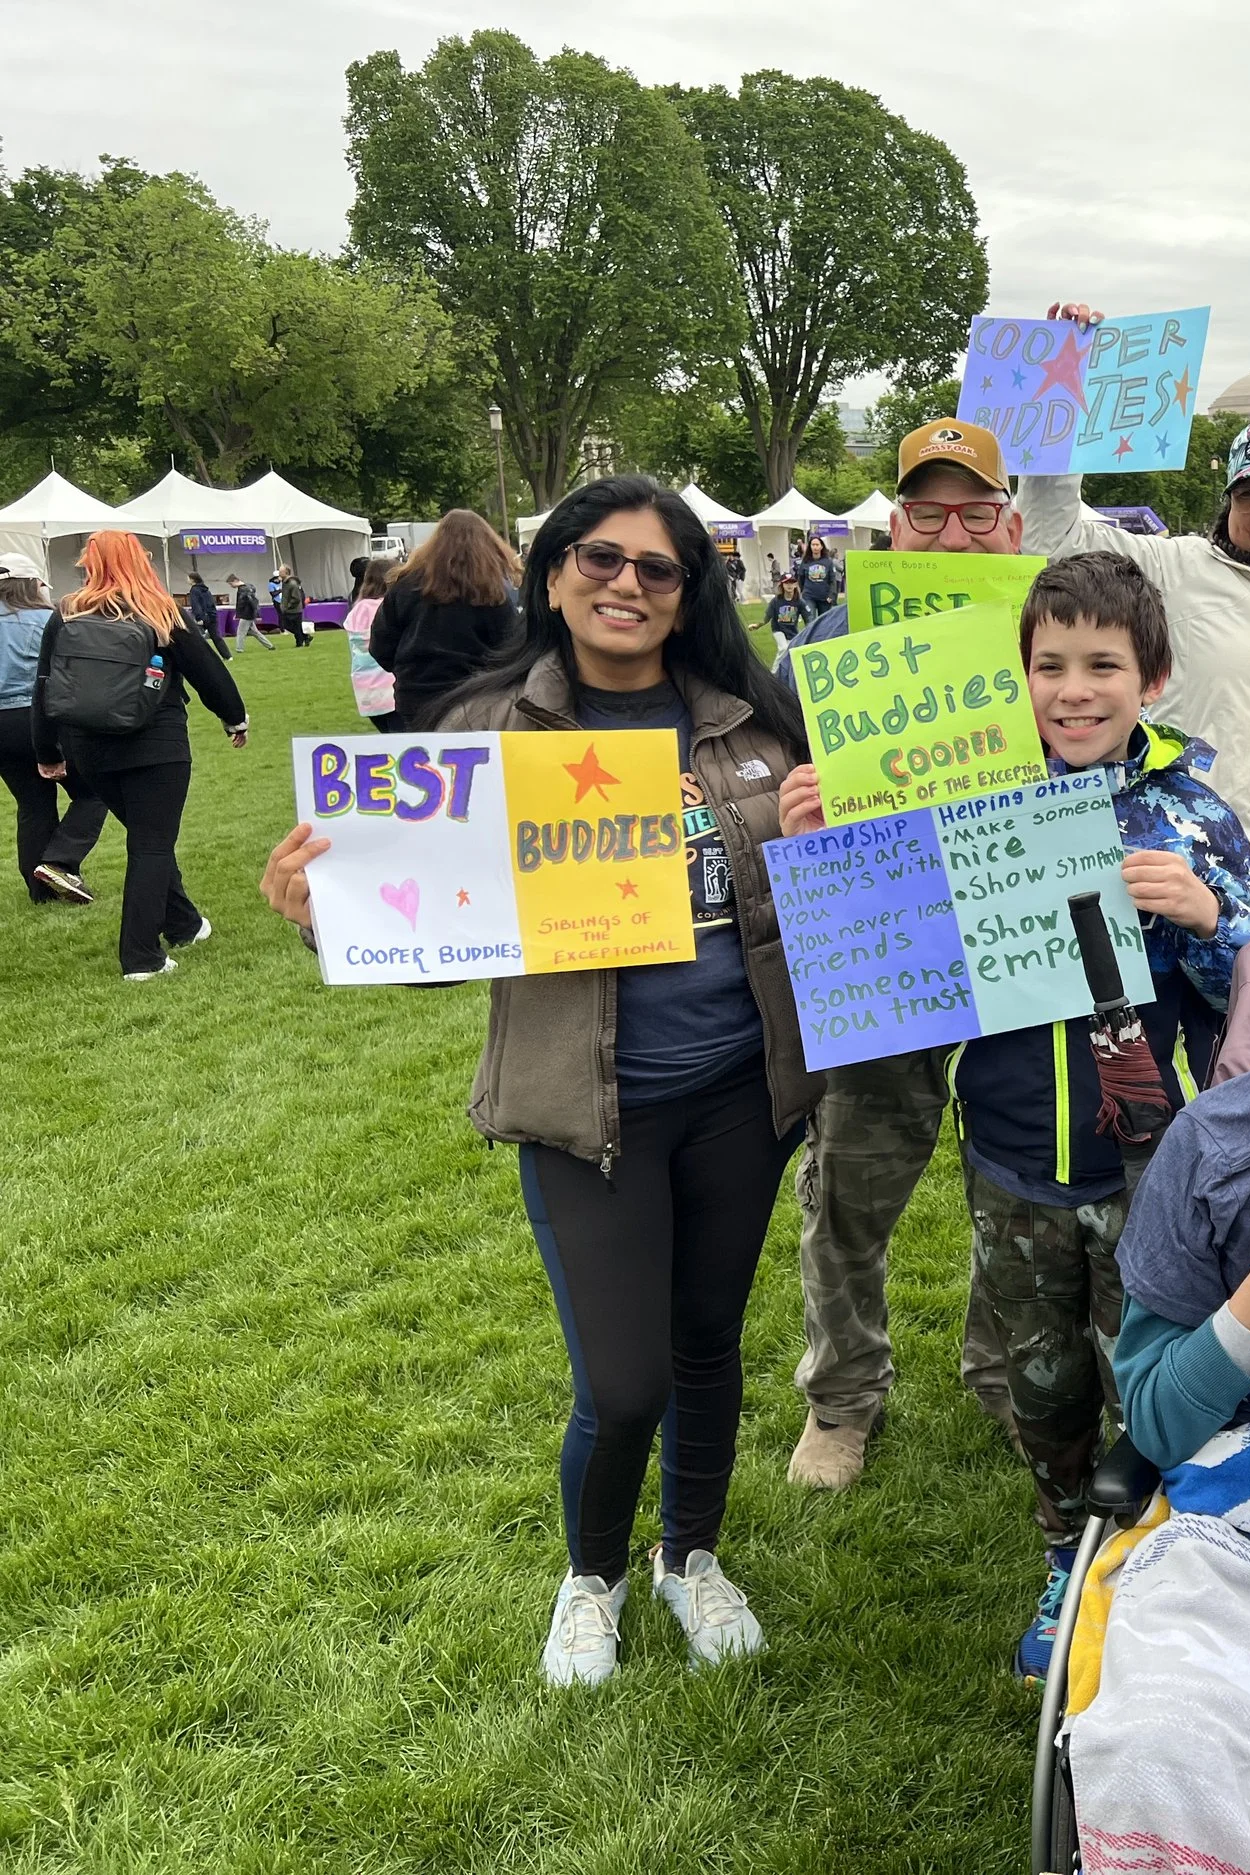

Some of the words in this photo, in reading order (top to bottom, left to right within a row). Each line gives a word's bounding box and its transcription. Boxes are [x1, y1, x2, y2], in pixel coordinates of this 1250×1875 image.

[974, 318, 1187, 369] COOPER
[973, 370, 1173, 447] BUDDIES
[201, 535, 266, 545] VOLUNTEERS
[870, 582, 972, 626] BEST
[802, 636, 931, 703] Best
[817, 669, 1019, 756] Buddies
[880, 724, 1007, 787] COOPER
[312, 743, 490, 823] BEST
[831, 789, 907, 818] SIBLINGS
[916, 781, 938, 800] OF
[944, 773, 972, 794] THE
[939, 793, 1023, 828] Helping
[1035, 773, 1104, 799] others
[516, 814, 684, 873] BUDDIES
[874, 838, 923, 863] are
[950, 836, 1026, 871] nice
[779, 871, 876, 910] always
[886, 855, 942, 882] with
[966, 865, 1046, 901] Show
[537, 915, 621, 935] SIBLINGS
[631, 912, 652, 926] OF
[581, 929, 610, 942] THE
[783, 907, 831, 930] you
[838, 911, 910, 936] never
[977, 909, 1060, 947] Show
[346, 946, 430, 973] COOPER
[439, 944, 522, 964] BUDDIES
[554, 940, 680, 965] EXCEPTIONAL
[790, 932, 913, 982] friends
[977, 916, 1144, 983] empahy
[810, 1007, 879, 1045] you
[888, 984, 971, 1025] trust
